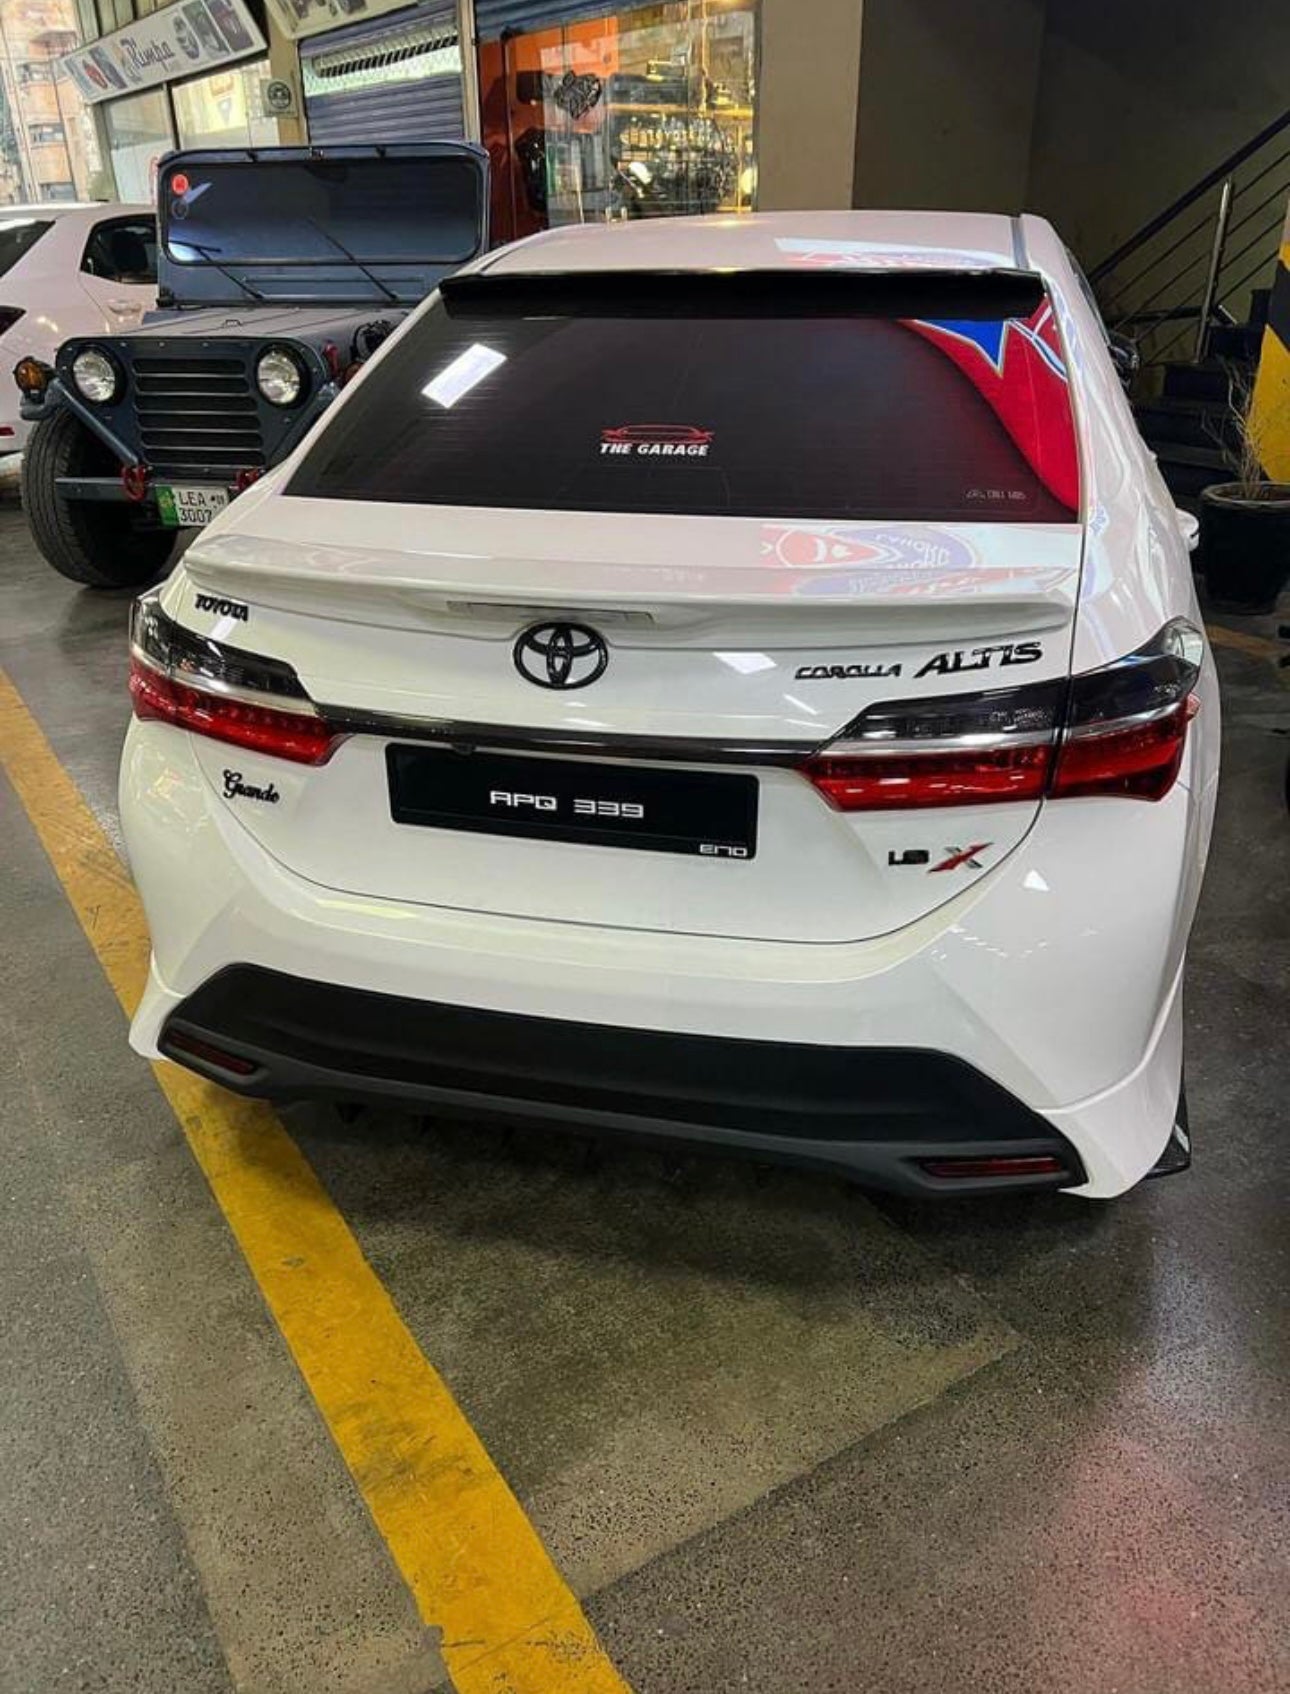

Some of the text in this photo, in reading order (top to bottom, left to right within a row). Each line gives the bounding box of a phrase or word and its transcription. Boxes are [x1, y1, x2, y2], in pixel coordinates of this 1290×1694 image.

[600, 443, 709, 456] THE GARAGE
[179, 491, 206, 506] LEA
[179, 507, 212, 523] 3007
[195, 593, 249, 622] TOYOTA
[795, 641, 1043, 680] COROLLA ALTIS
[223, 769, 280, 804] Grande
[490, 790, 644, 819] APQ 339
